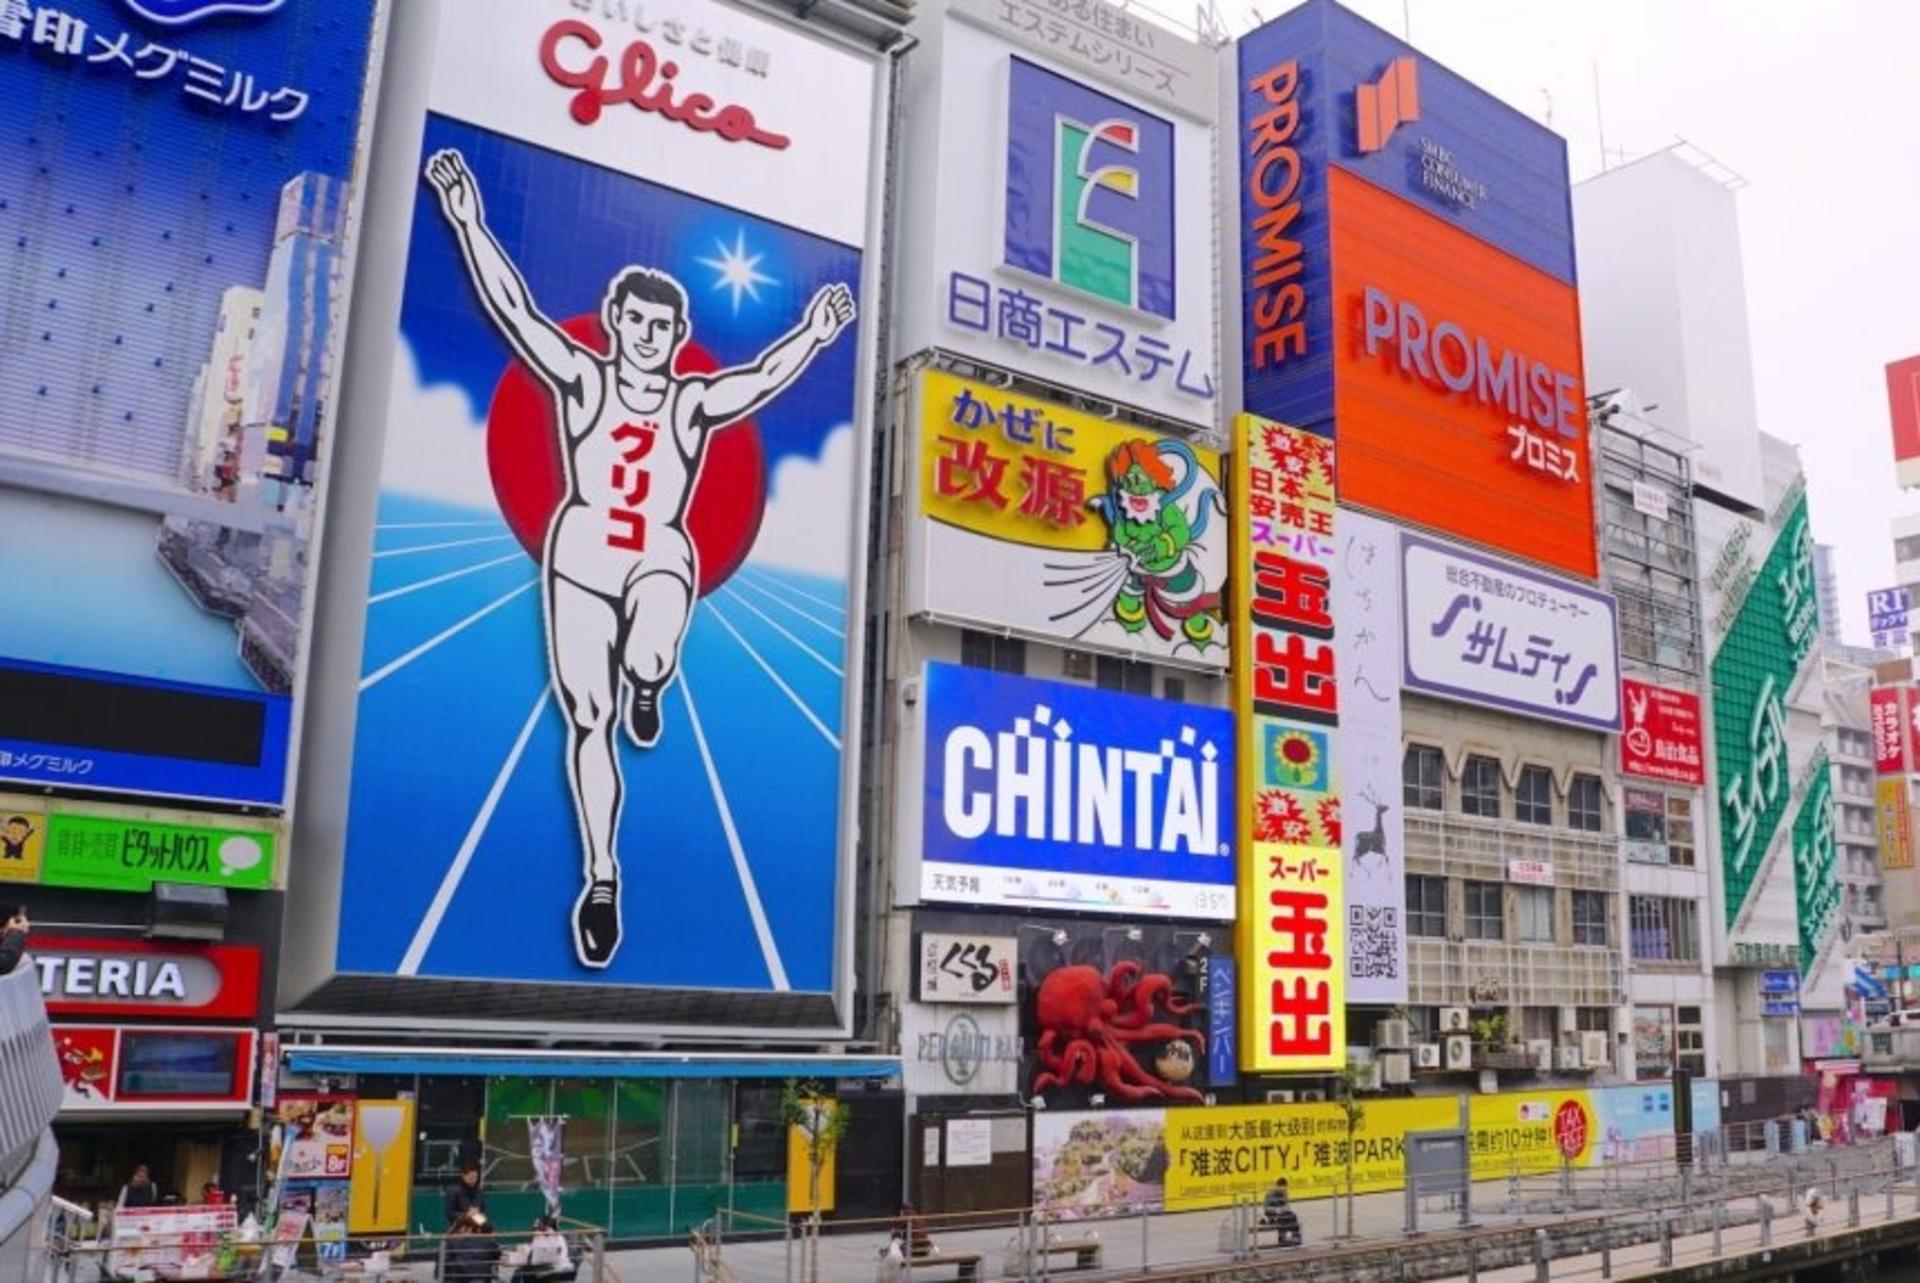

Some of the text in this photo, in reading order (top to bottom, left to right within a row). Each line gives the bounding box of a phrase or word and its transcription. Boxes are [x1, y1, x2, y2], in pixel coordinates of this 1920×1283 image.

[1250, 58, 1306, 369] PROMISE
[949, 270, 1217, 399] 日商エステム
[1364, 285, 1578, 440] PROMISE
[953, 387, 1075, 454] かぜに
[1506, 424, 1580, 484] プロミス
[607, 420, 660, 553] グリコ
[935, 435, 1088, 530] 改源
[1251, 467, 1331, 503] 日本一
[1252, 521, 1335, 557] スーパー
[1251, 550, 1337, 718] 玉出
[943, 703, 1219, 857] CHINTAI
[121, 828, 209, 872] ピタットハウス
[1269, 855, 1329, 883] スーパー
[1267, 889, 1332, 1056] 玉出
